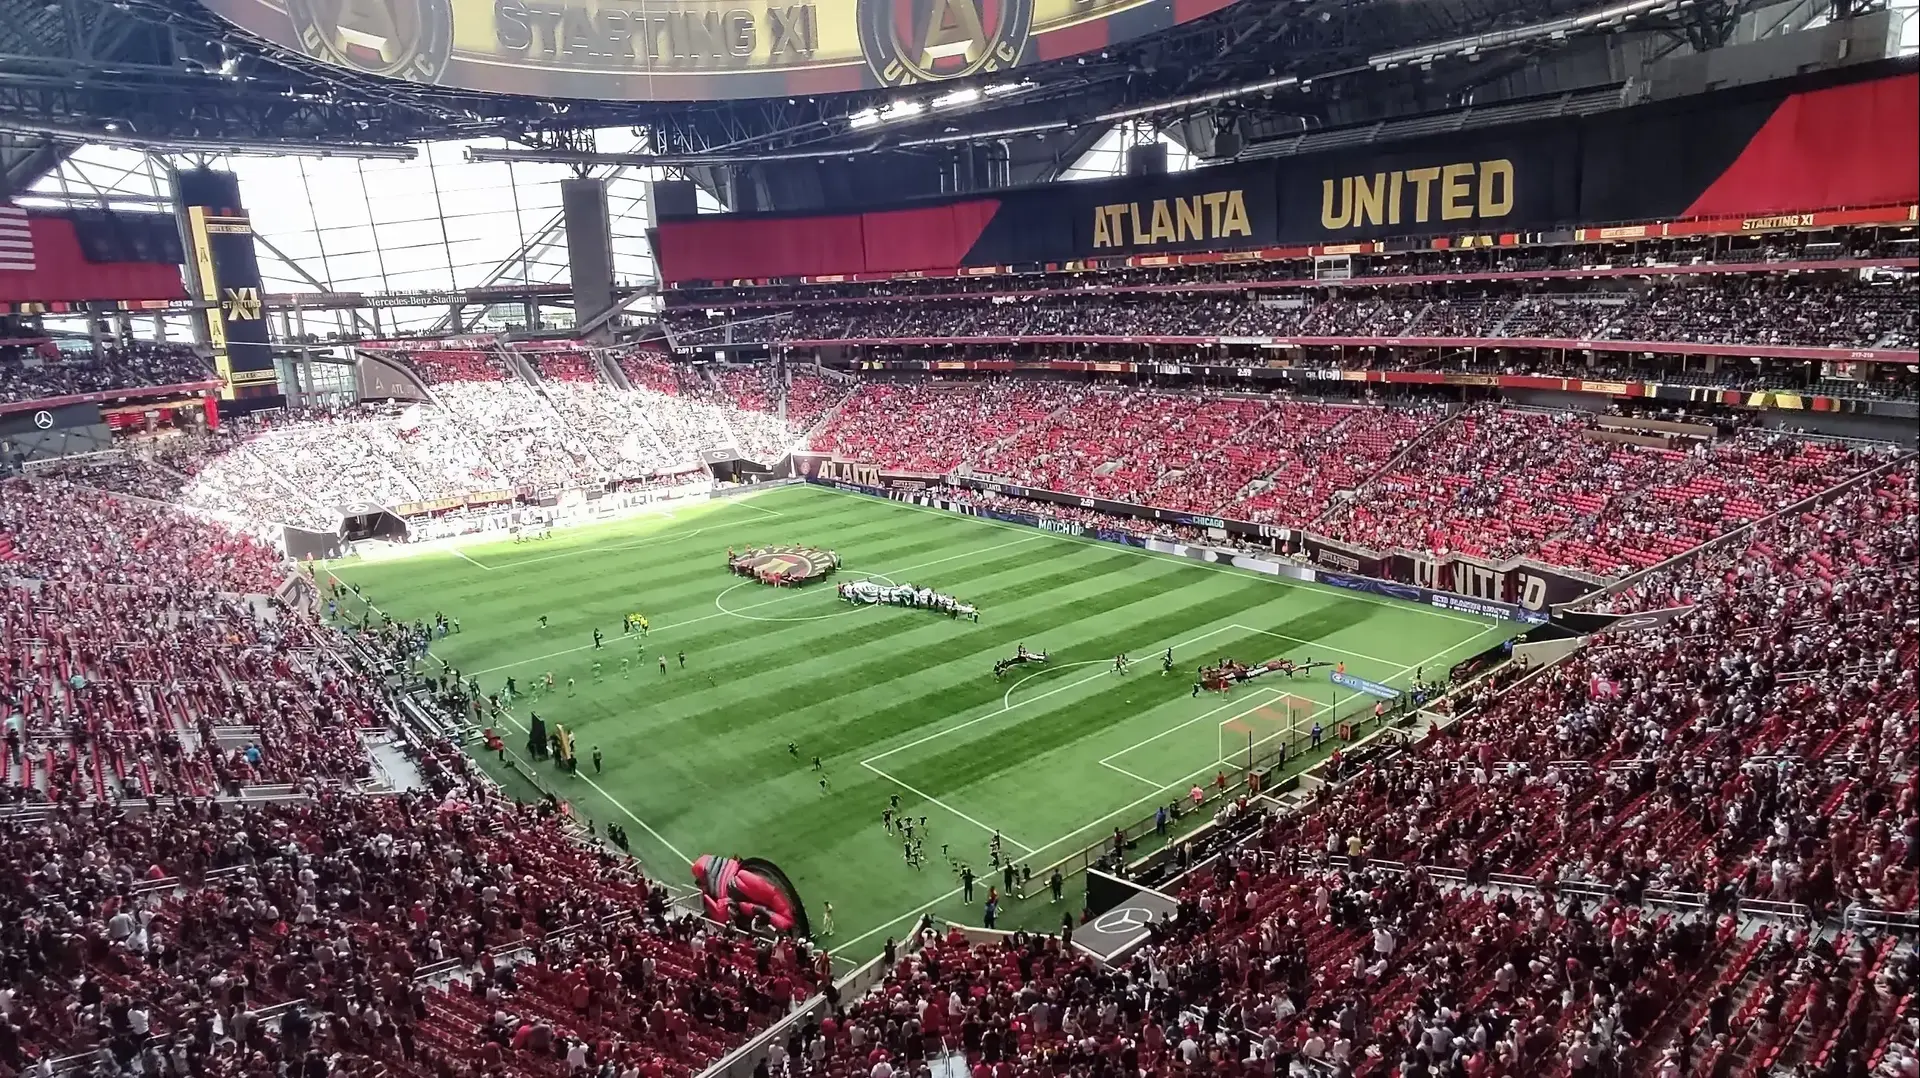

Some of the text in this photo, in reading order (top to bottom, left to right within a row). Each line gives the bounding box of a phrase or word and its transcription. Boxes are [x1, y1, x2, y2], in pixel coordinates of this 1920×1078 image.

[495, 1, 818, 58] STARTING XI
[1093, 158, 1514, 248] ATLANTA UNITED
[1741, 214, 1814, 230] STARTING XI
[223, 287, 261, 320] XI
[366, 295, 467, 307] Mercedes-Benz Stadium
[1237, 368, 1251, 376] 2:59
[1080, 497, 1095, 507] 2:59
[1192, 516, 1225, 529] CHICAGO
[1038, 518, 1084, 536] MATCH UP
